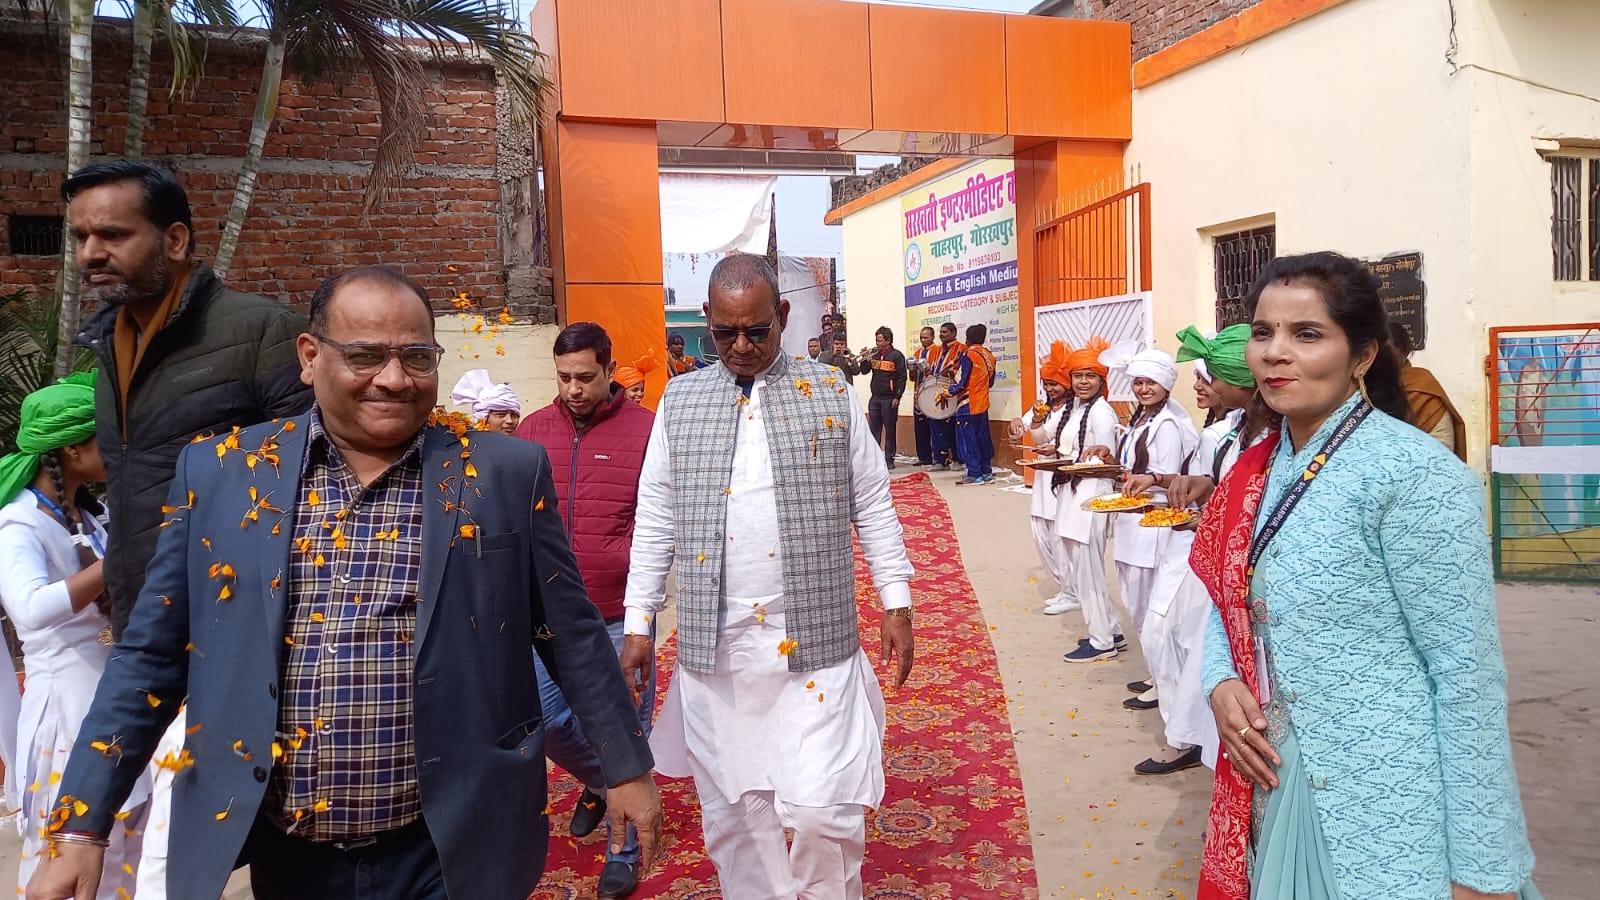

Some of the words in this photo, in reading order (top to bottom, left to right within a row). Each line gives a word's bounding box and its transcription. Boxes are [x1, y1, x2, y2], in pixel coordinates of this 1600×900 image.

[922, 284, 943, 298] Hindi
[945, 279, 953, 293] &
[954, 274, 986, 292] English
[989, 265, 1018, 284] Mediu
[927, 302, 960, 315] RECOGNIZED
[960, 296, 989, 310] CATEGORY
[995, 290, 1018, 302] SUBJEC
[1323, 417, 1357, 454] GORAKHPUR
